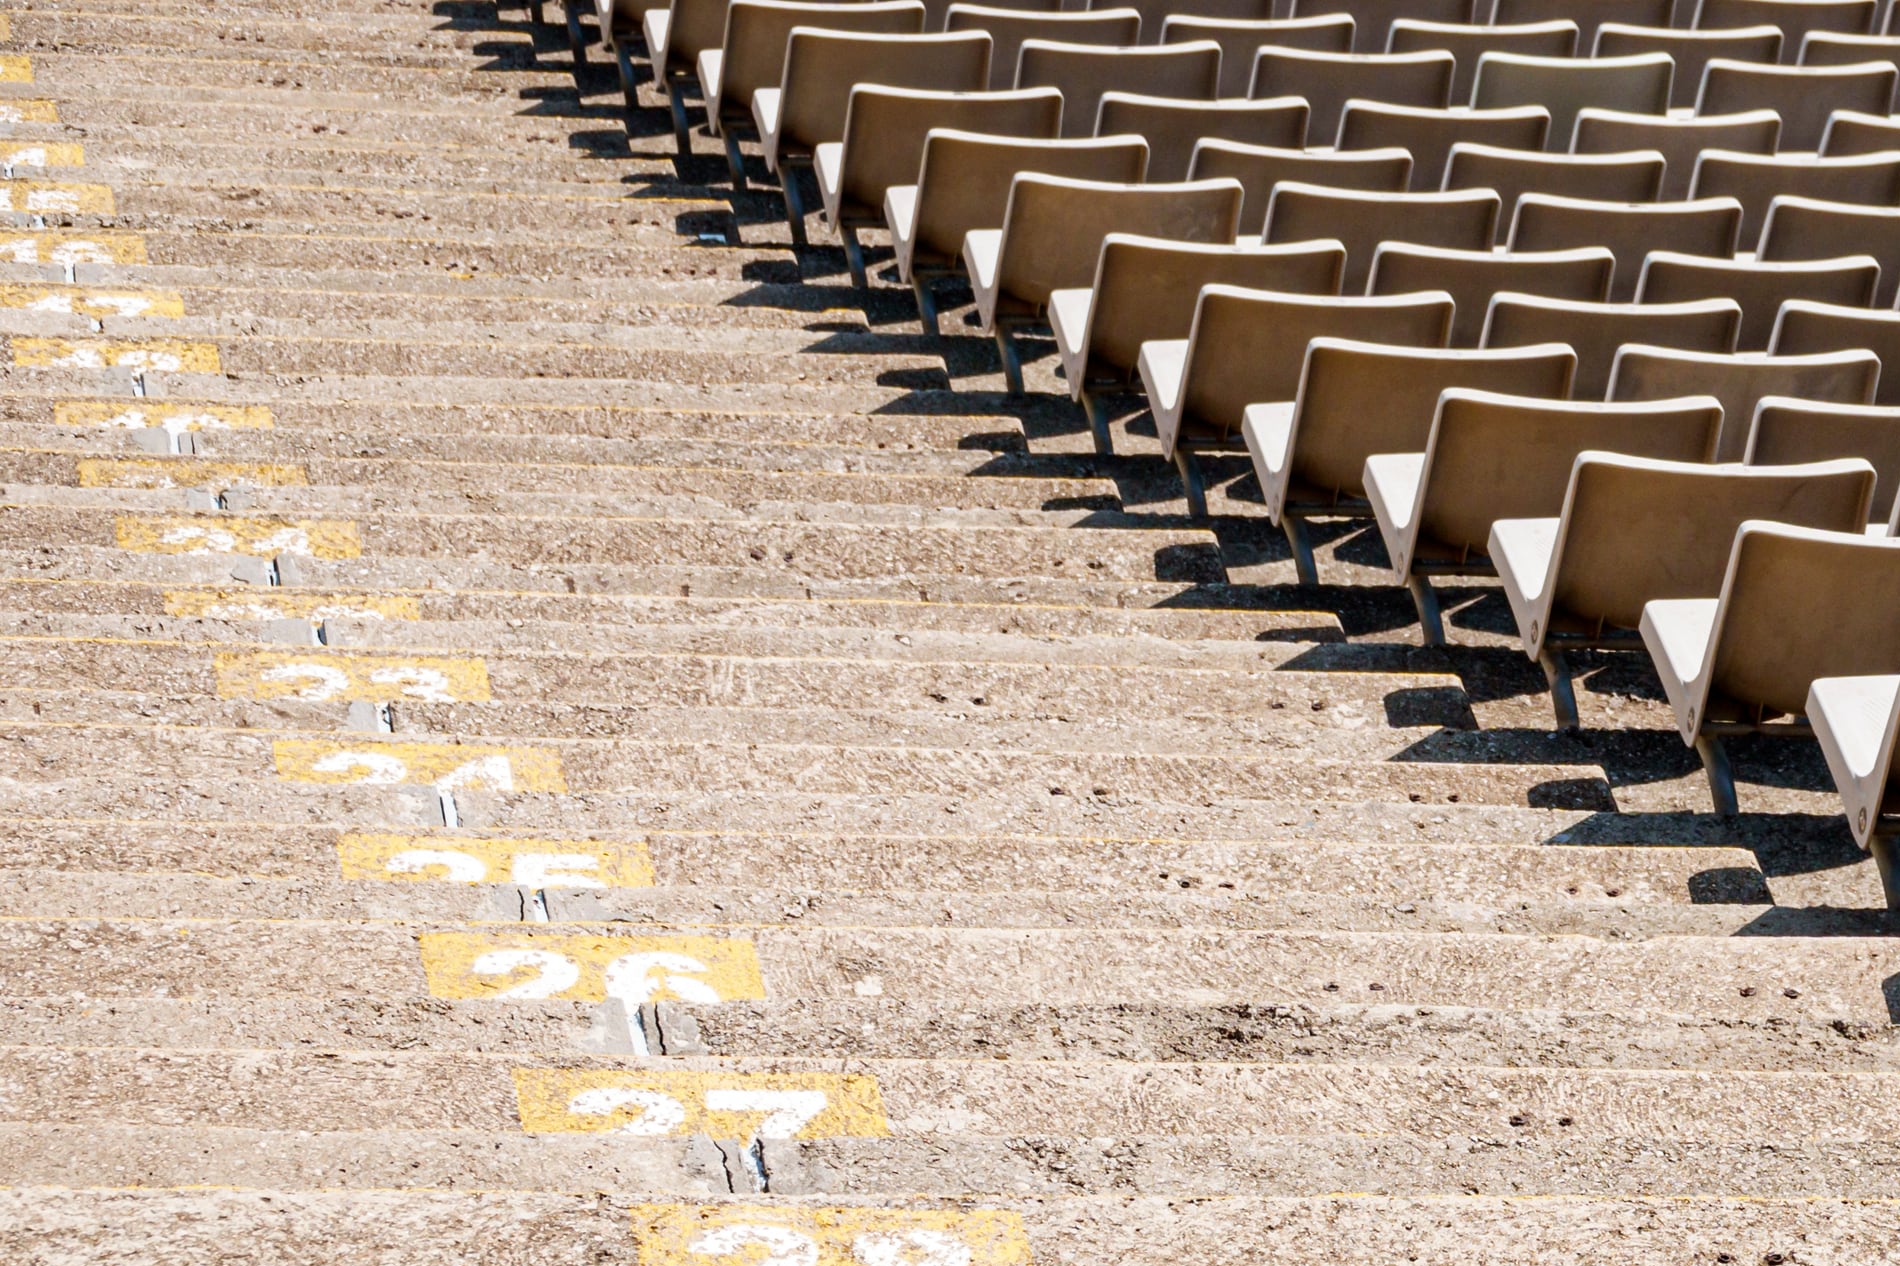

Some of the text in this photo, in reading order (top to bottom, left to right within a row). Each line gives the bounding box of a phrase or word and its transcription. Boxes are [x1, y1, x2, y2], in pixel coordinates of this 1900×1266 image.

[260, 662, 456, 703] 23
[312, 751, 515, 794] 24
[385, 848, 609, 890] 25
[472, 949, 721, 1003] 26
[568, 1087, 829, 1139] 27
